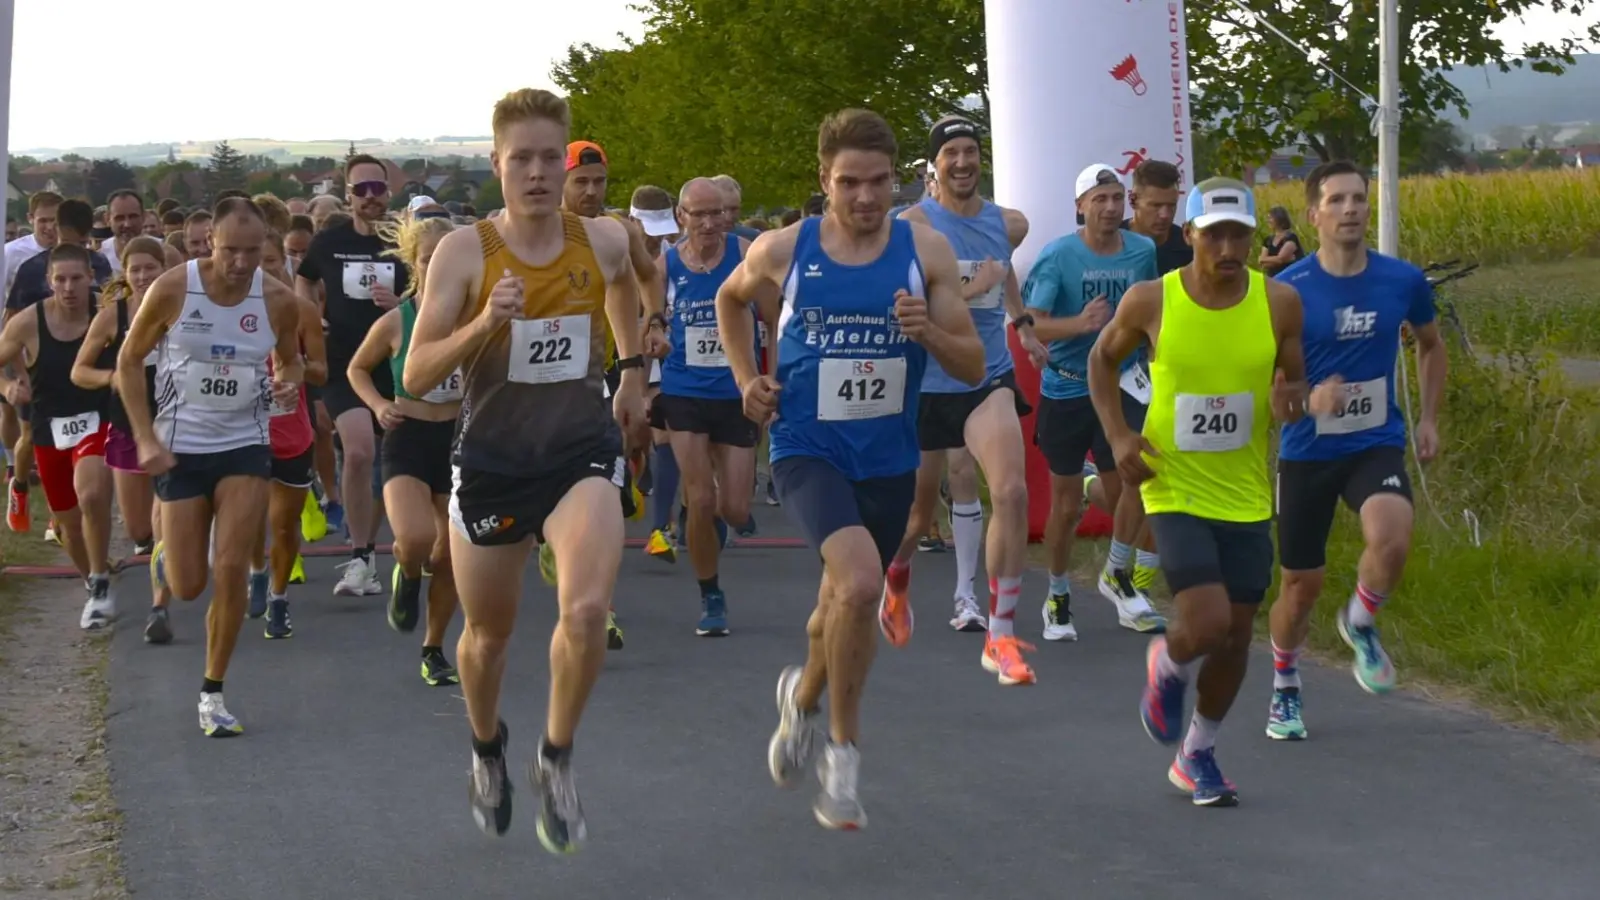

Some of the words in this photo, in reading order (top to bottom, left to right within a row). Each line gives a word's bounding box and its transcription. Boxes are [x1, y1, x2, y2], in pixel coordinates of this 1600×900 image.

[543, 320, 560, 336] RS
[826, 314, 885, 325] Autohaus
[705, 328, 719, 338] RS
[805, 329, 908, 349] Eyßelein
[528, 337, 572, 365] 222
[214, 364, 230, 376] RS
[852, 360, 875, 375] RS
[200, 377, 239, 397] 368
[837, 378, 887, 401] 412
[1205, 397, 1225, 411] RS
[61, 419, 88, 437] 403
[1192, 412, 1238, 434] 240
[472, 514, 500, 535] LSC
